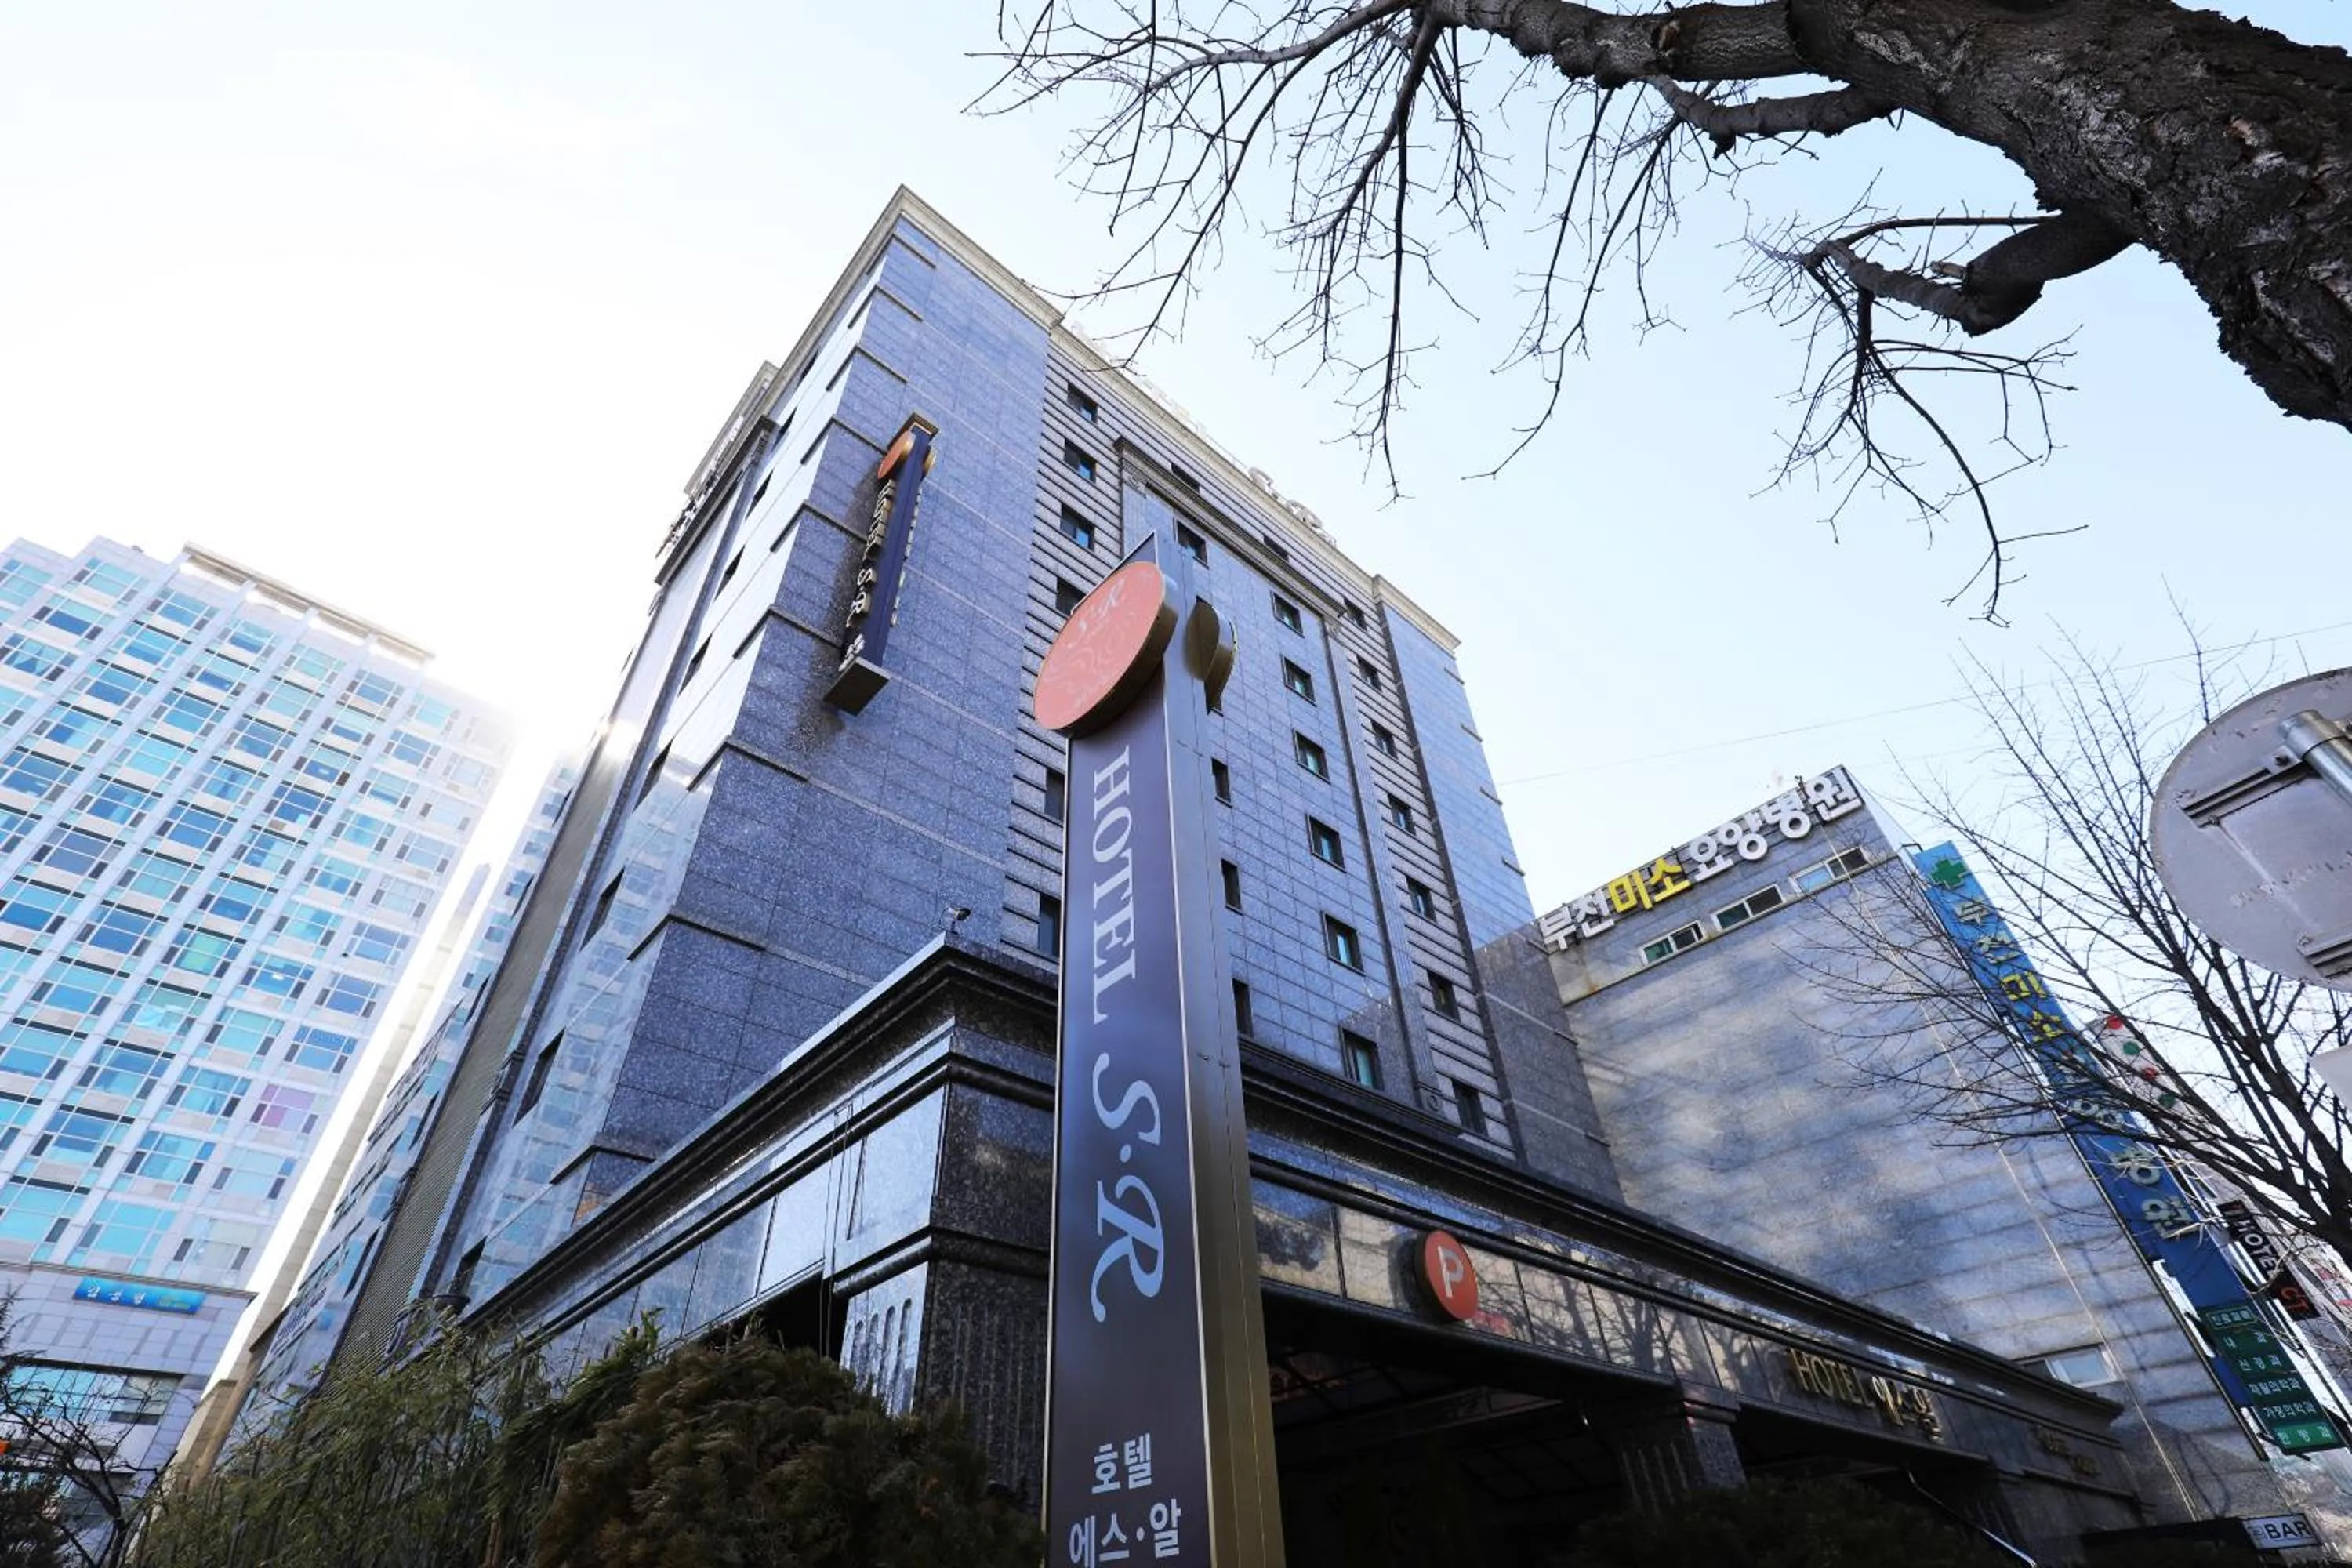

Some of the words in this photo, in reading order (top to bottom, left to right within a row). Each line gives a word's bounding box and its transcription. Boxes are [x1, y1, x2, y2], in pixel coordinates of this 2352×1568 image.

[1092, 746, 1135, 1025] HOTEL
[1436, 1245, 1464, 1299] P
[1790, 1348, 1875, 1409] HOTEL
[1091, 1432, 1152, 1494] 호텔
[2263, 1520, 2311, 1539] BAR
